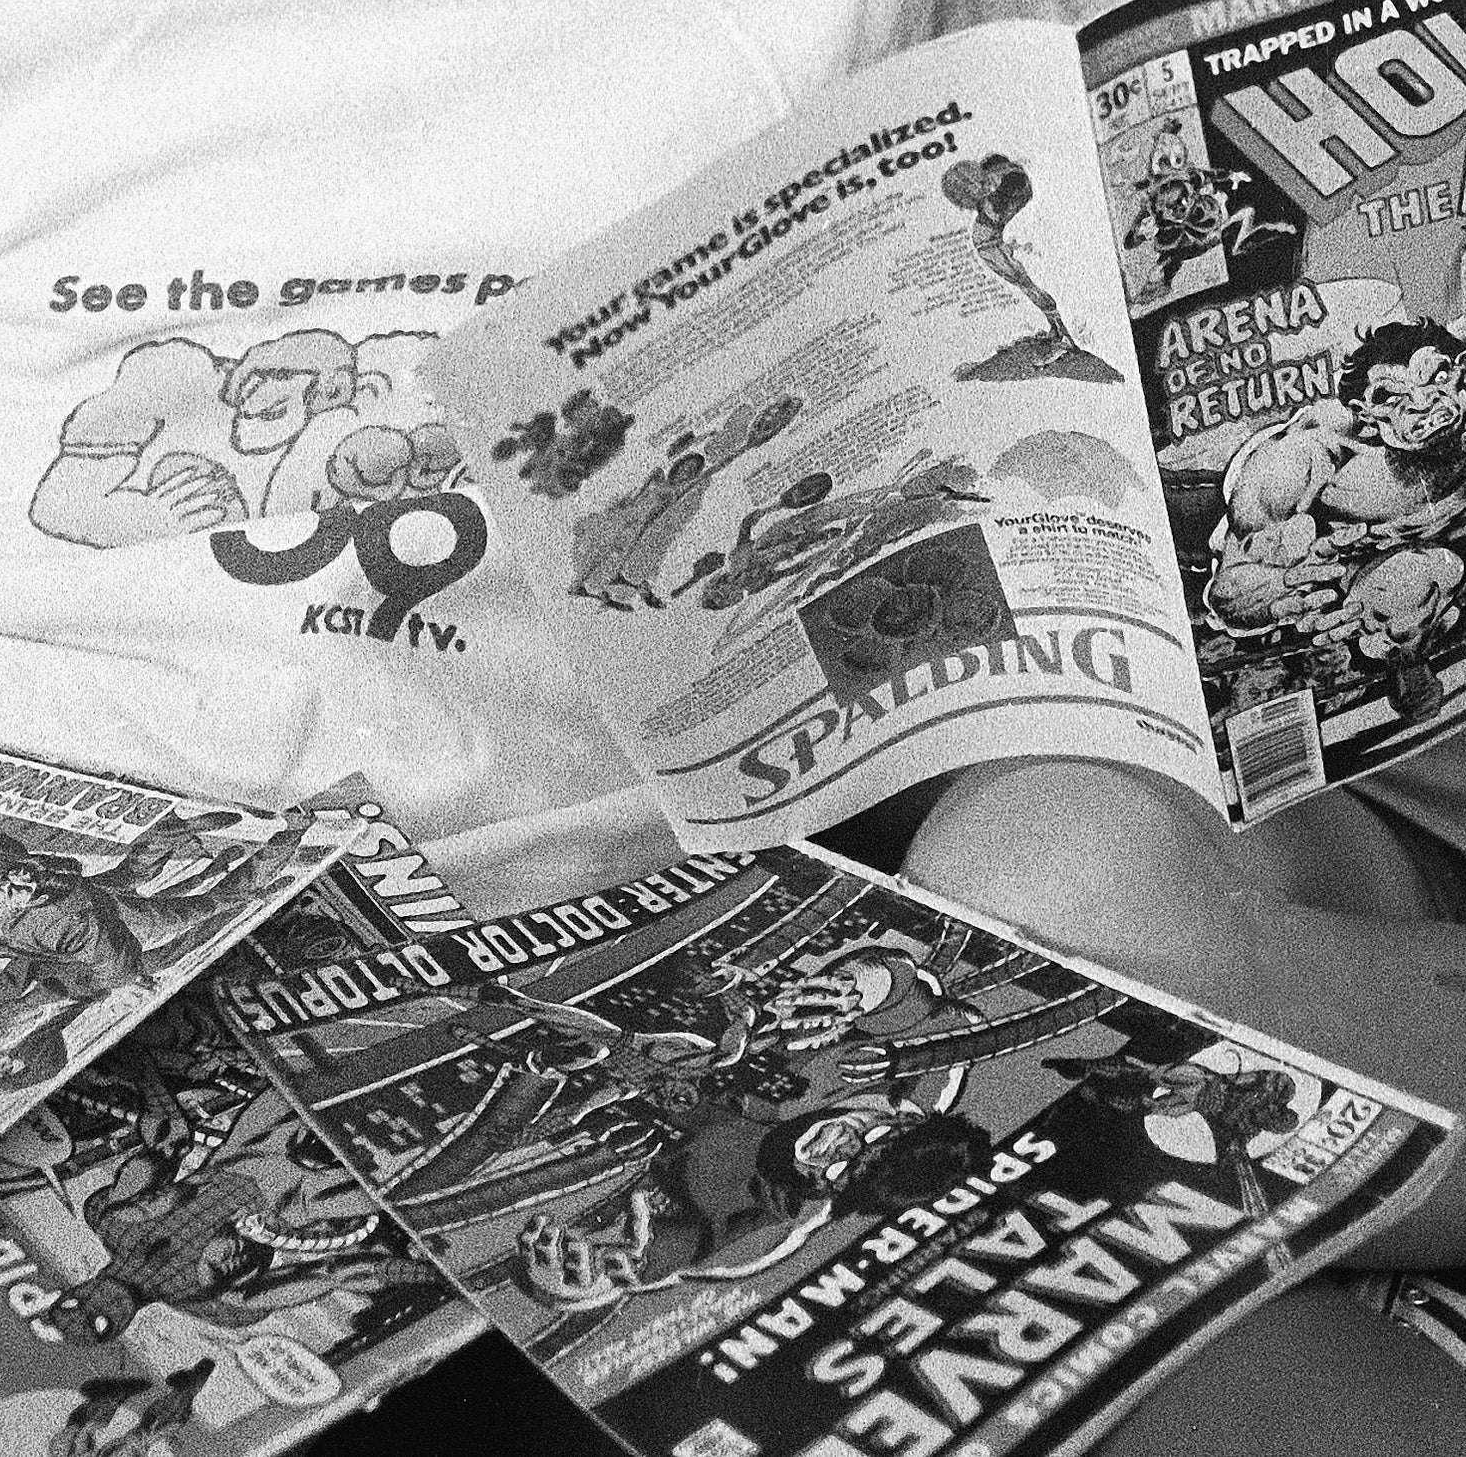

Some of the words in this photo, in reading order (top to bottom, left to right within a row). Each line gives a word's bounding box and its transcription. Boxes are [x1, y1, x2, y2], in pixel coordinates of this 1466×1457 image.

[1160, 59, 1175, 85] 5
[1204, 18, 1337, 75] TRAPPED
[1343, 7, 1375, 37] IN
[545, 290, 627, 355] Your
[632, 231, 730, 306] game
[731, 207, 760, 237] is
[762, 100, 973, 214] specialized.
[569, 306, 652, 371] Now
[835, 173, 879, 201] is,
[876, 131, 959, 179] too!
[1357, 181, 1459, 241] THE
[48, 274, 148, 312] See
[166, 269, 260, 311] the
[278, 271, 467, 308] games
[1157, 282, 1327, 369] ARENA
[1166, 357, 1212, 391] OF
[1218, 341, 1272, 378] NO
[1168, 358, 1333, 437] RETURN
[406, 613, 467, 653] tv.
[739, 626, 1134, 810] SPALDING
[451, 895, 632, 972] DOCTOR
[700, 1131, 1058, 1384] SPIDER-MAN!
[1171, 1196, 1320, 1295] MARVEL
[812, 1192, 1111, 1398] TALES
[1005, 1303, 1157, 1426] COMICS
